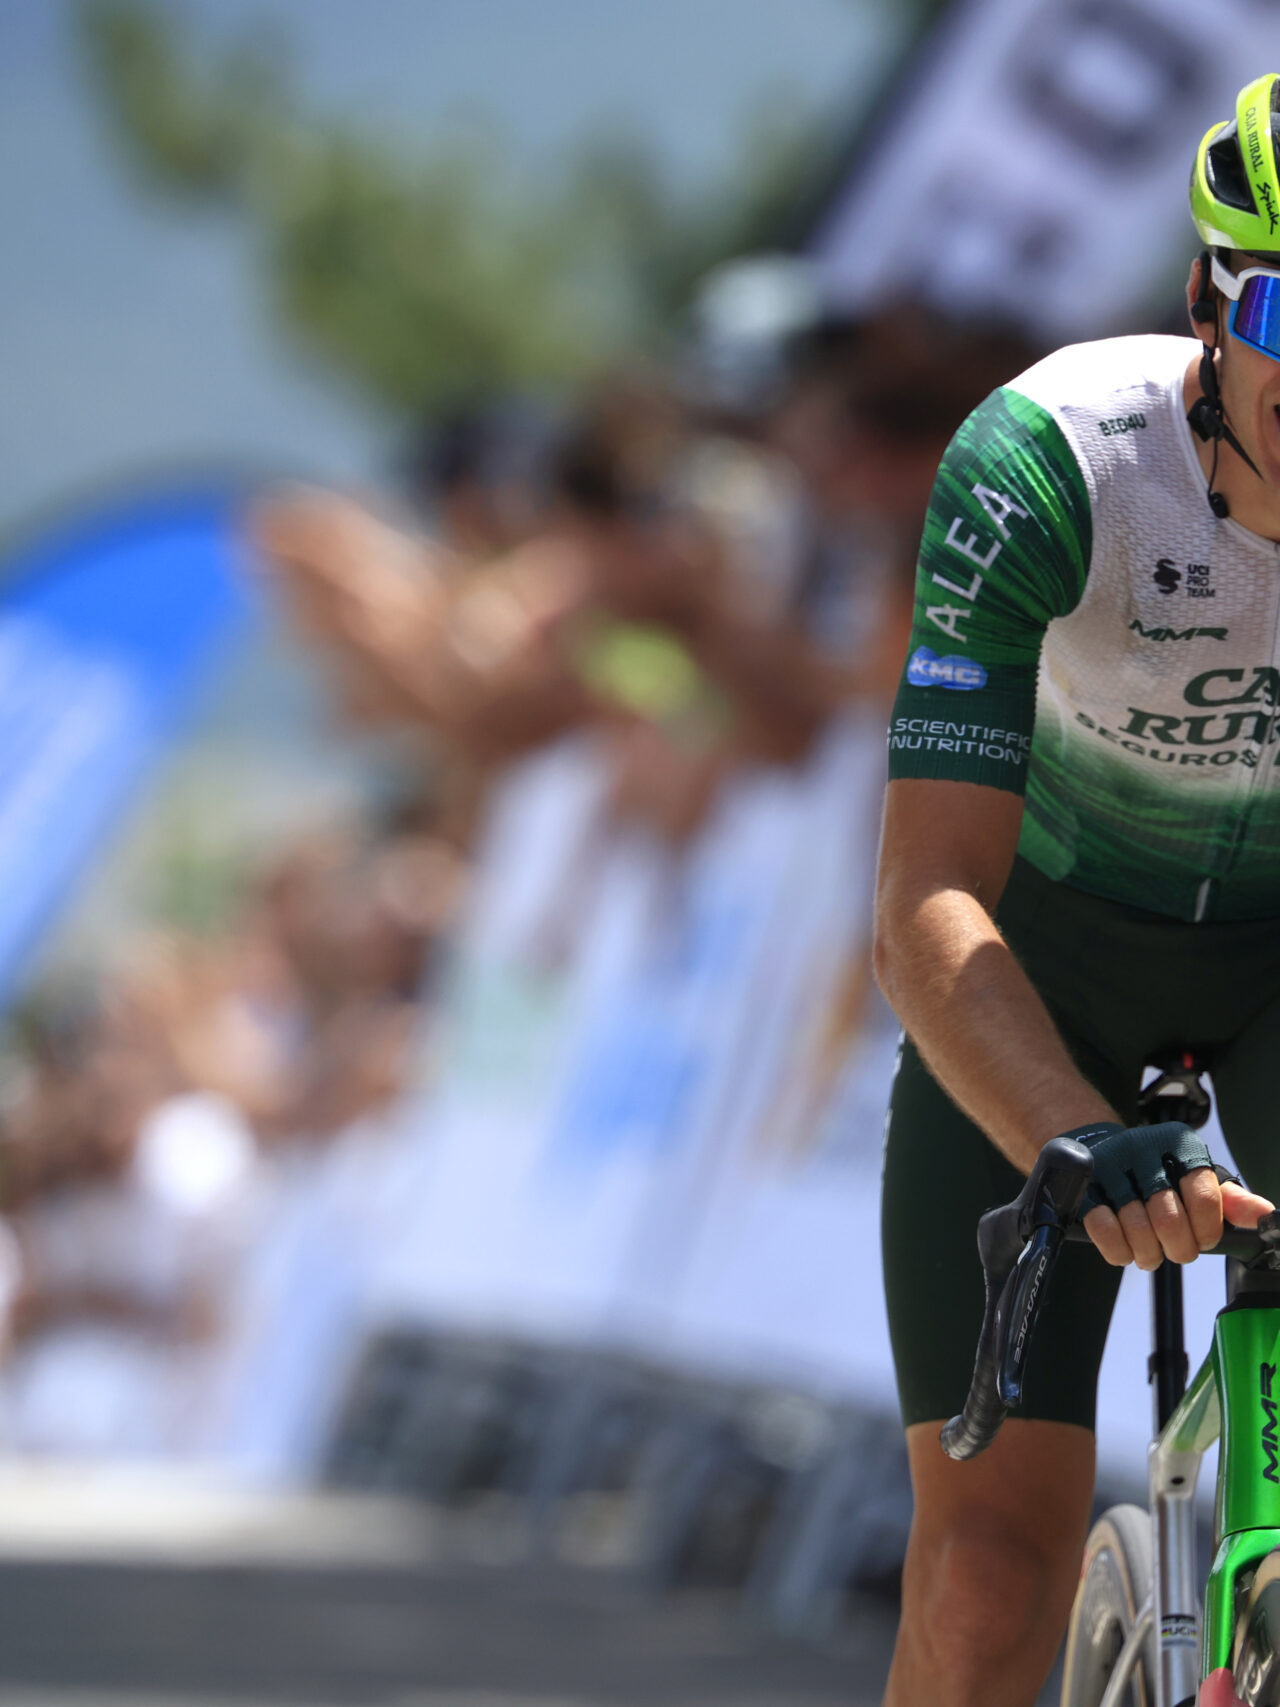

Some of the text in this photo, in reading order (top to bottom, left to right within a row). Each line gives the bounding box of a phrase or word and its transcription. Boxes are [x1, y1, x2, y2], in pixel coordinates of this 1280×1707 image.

[1247, 130, 1264, 173] RURAL
[926, 482, 1030, 644] ALEA
[1186, 575, 1210, 587] PRO
[1187, 563, 1210, 576] UCI
[1186, 587, 1216, 598] TEAM
[910, 656, 981, 685] KMC
[890, 735, 1022, 766] NUTRITION
[1075, 711, 1258, 768] SEGUROS
[1013, 1255, 1048, 1364] DURA-ACE
[1259, 1361, 1280, 1484] MMR
